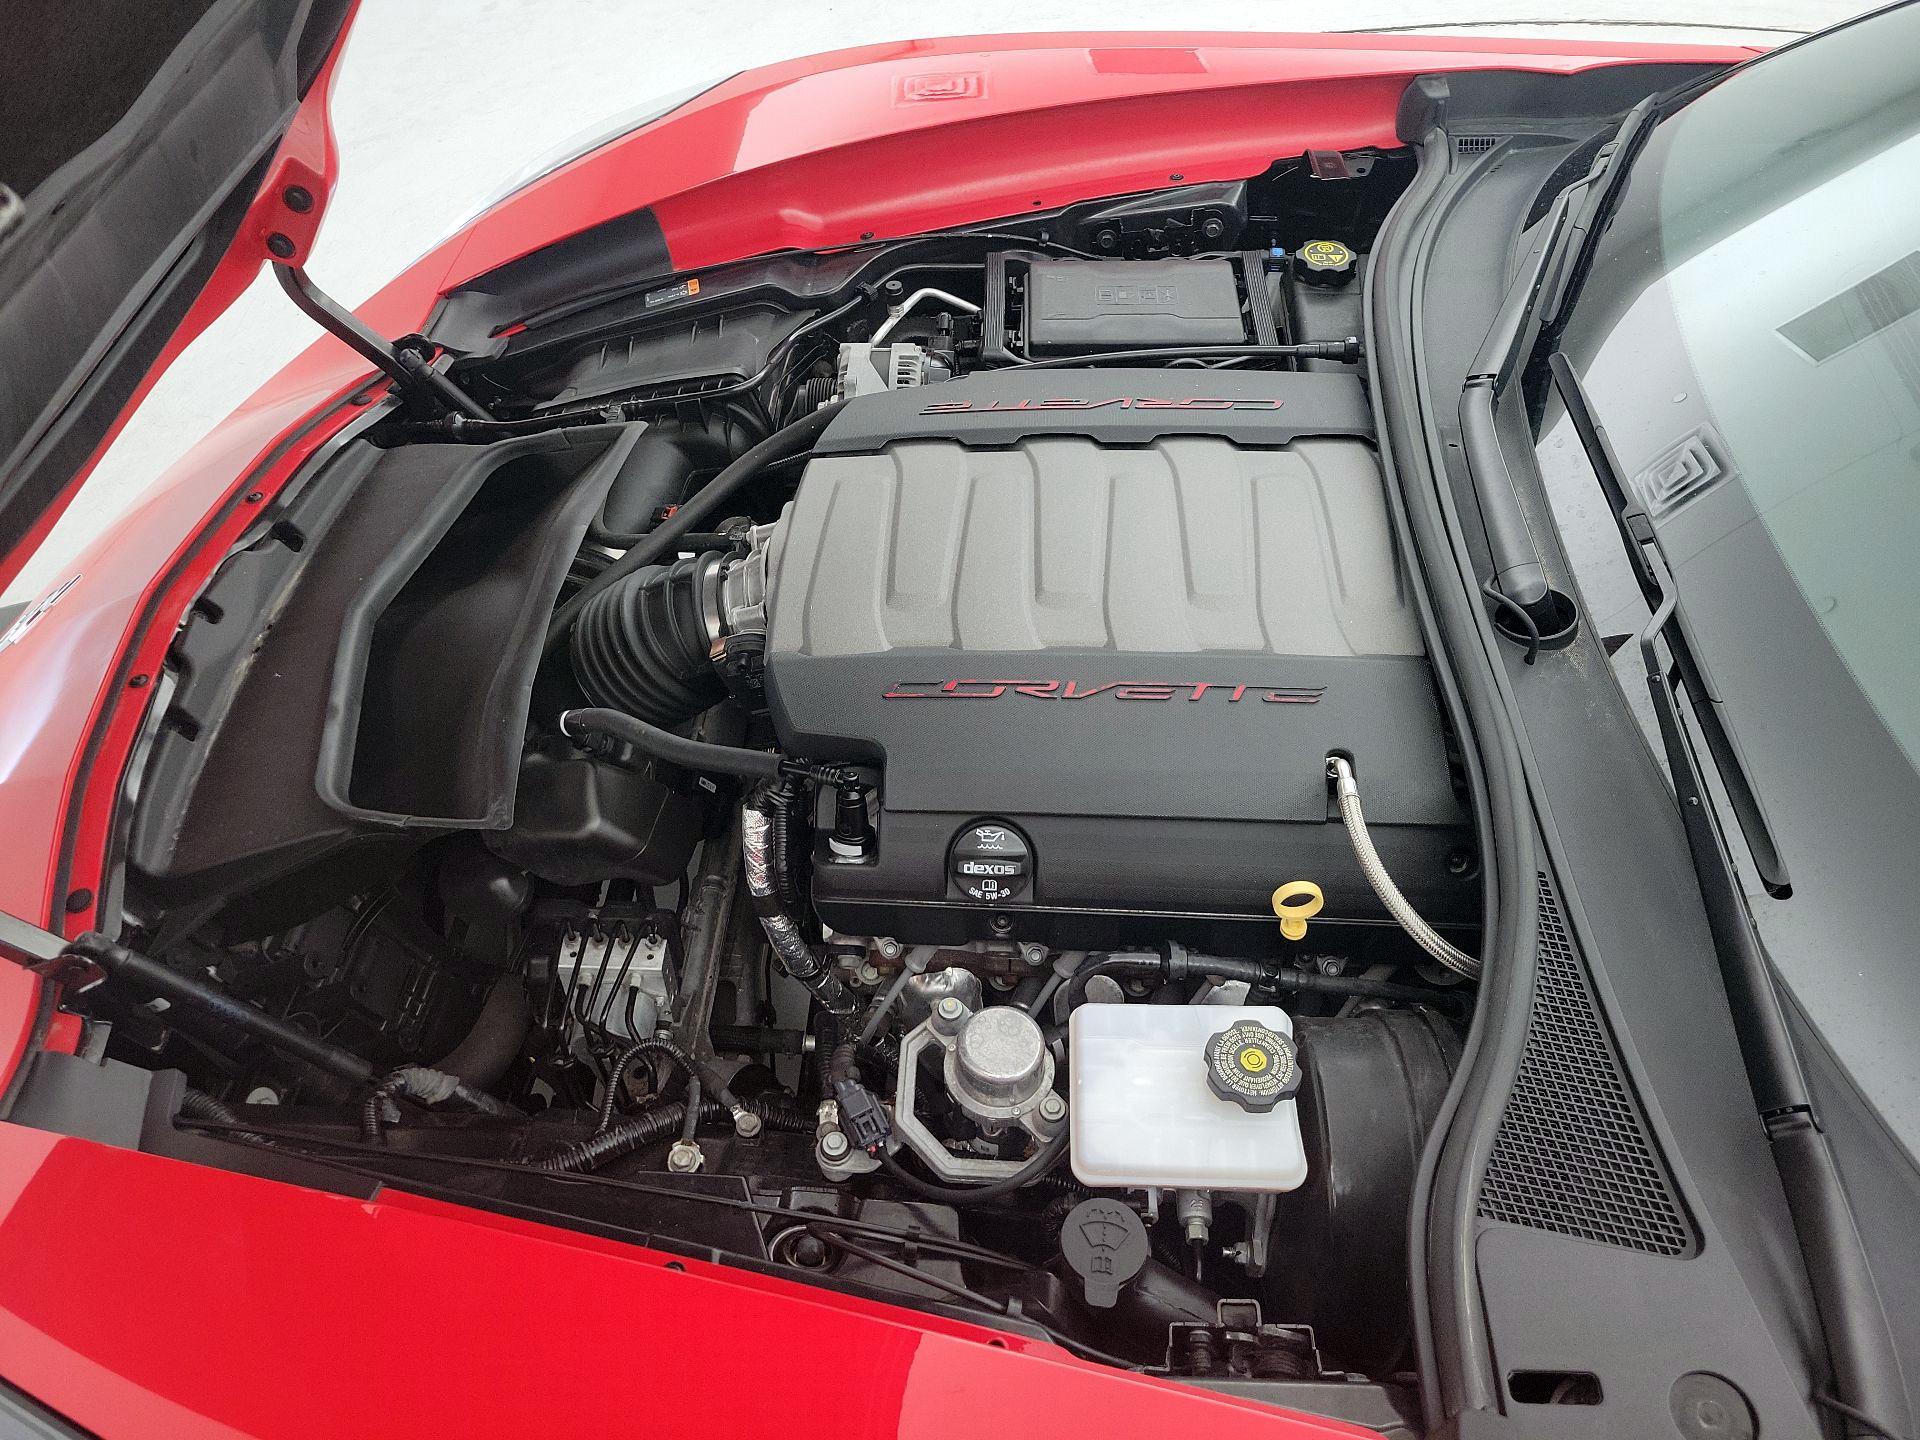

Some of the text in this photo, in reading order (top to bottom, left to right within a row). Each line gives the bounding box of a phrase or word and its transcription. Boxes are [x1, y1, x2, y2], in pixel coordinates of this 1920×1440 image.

[918, 397, 1285, 416] CORVETTE
[882, 679, 1328, 704] CORVETTE
[963, 861, 1016, 875] dexos
[968, 886, 1011, 900] SAE 5W-30
